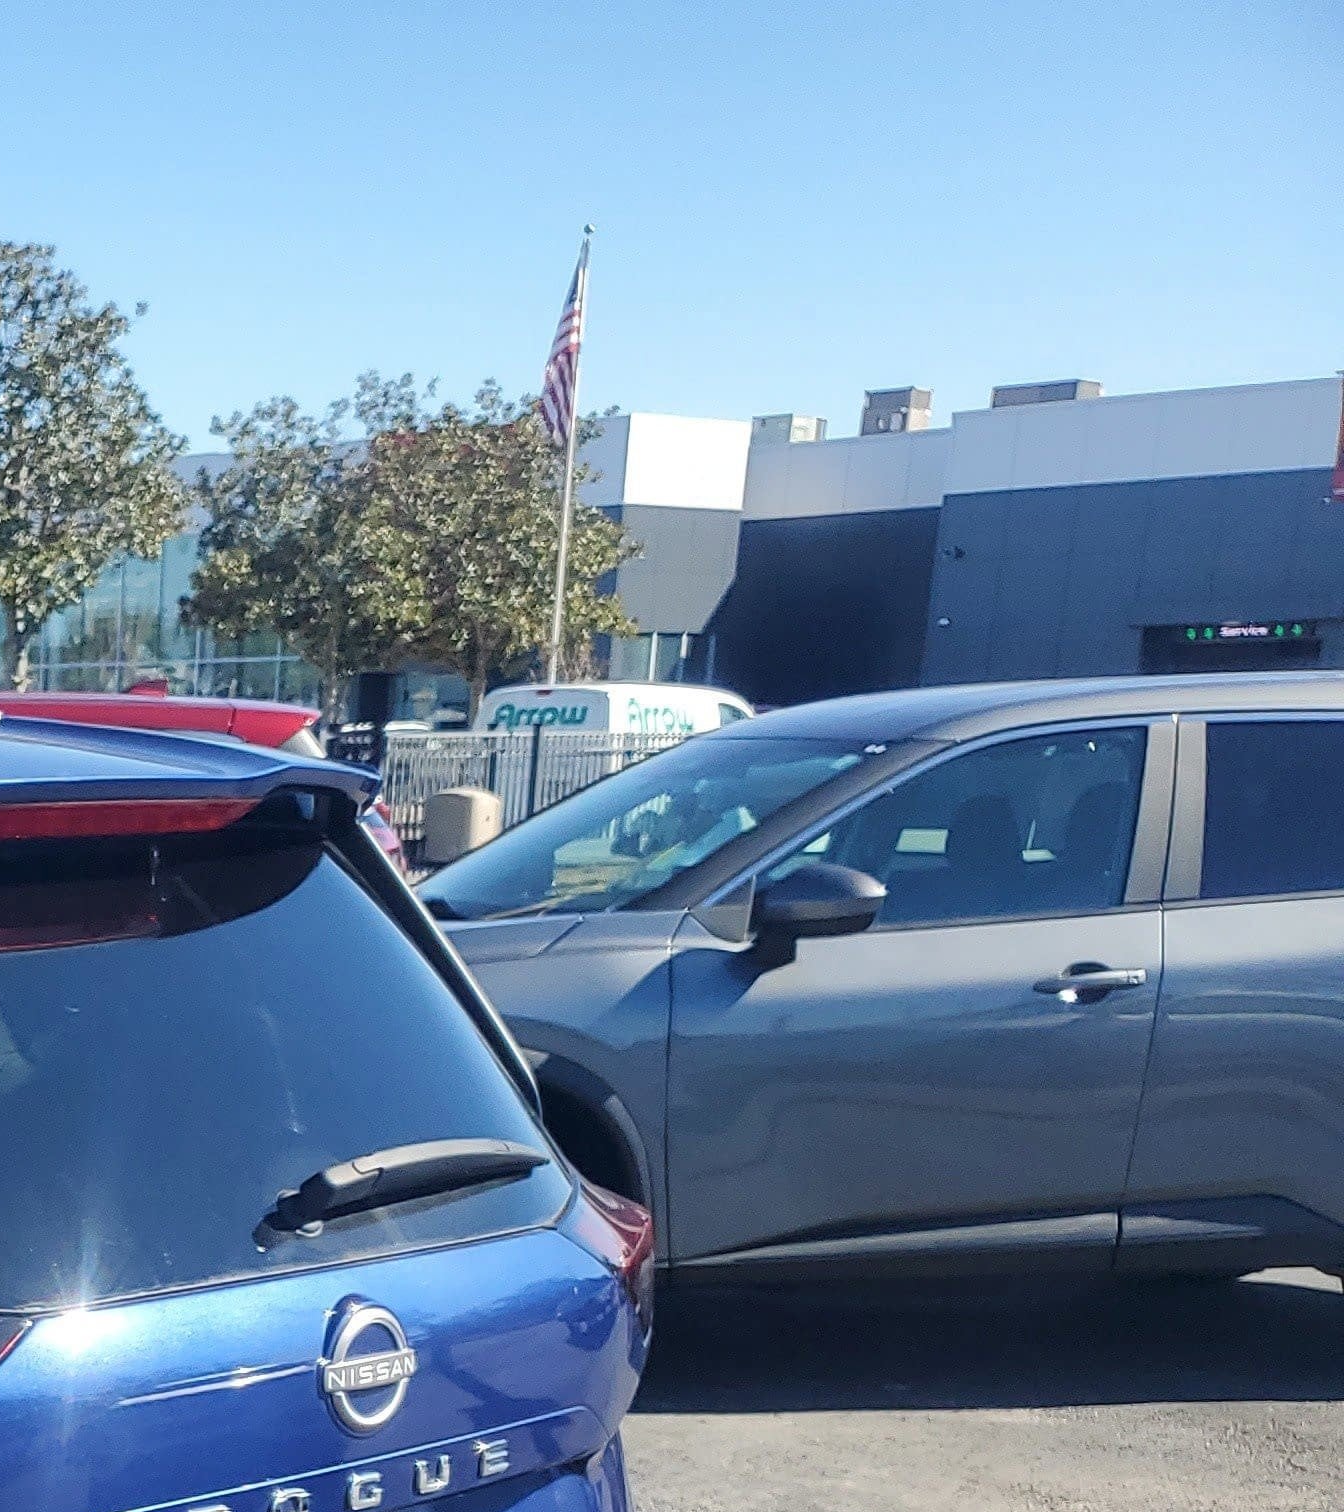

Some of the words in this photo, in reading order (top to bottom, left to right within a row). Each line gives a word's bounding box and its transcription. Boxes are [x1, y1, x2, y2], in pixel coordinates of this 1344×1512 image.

[494, 703, 588, 733] Arrow
[627, 698, 693, 733] Arrow
[328, 1356, 415, 1389] NISSAN
